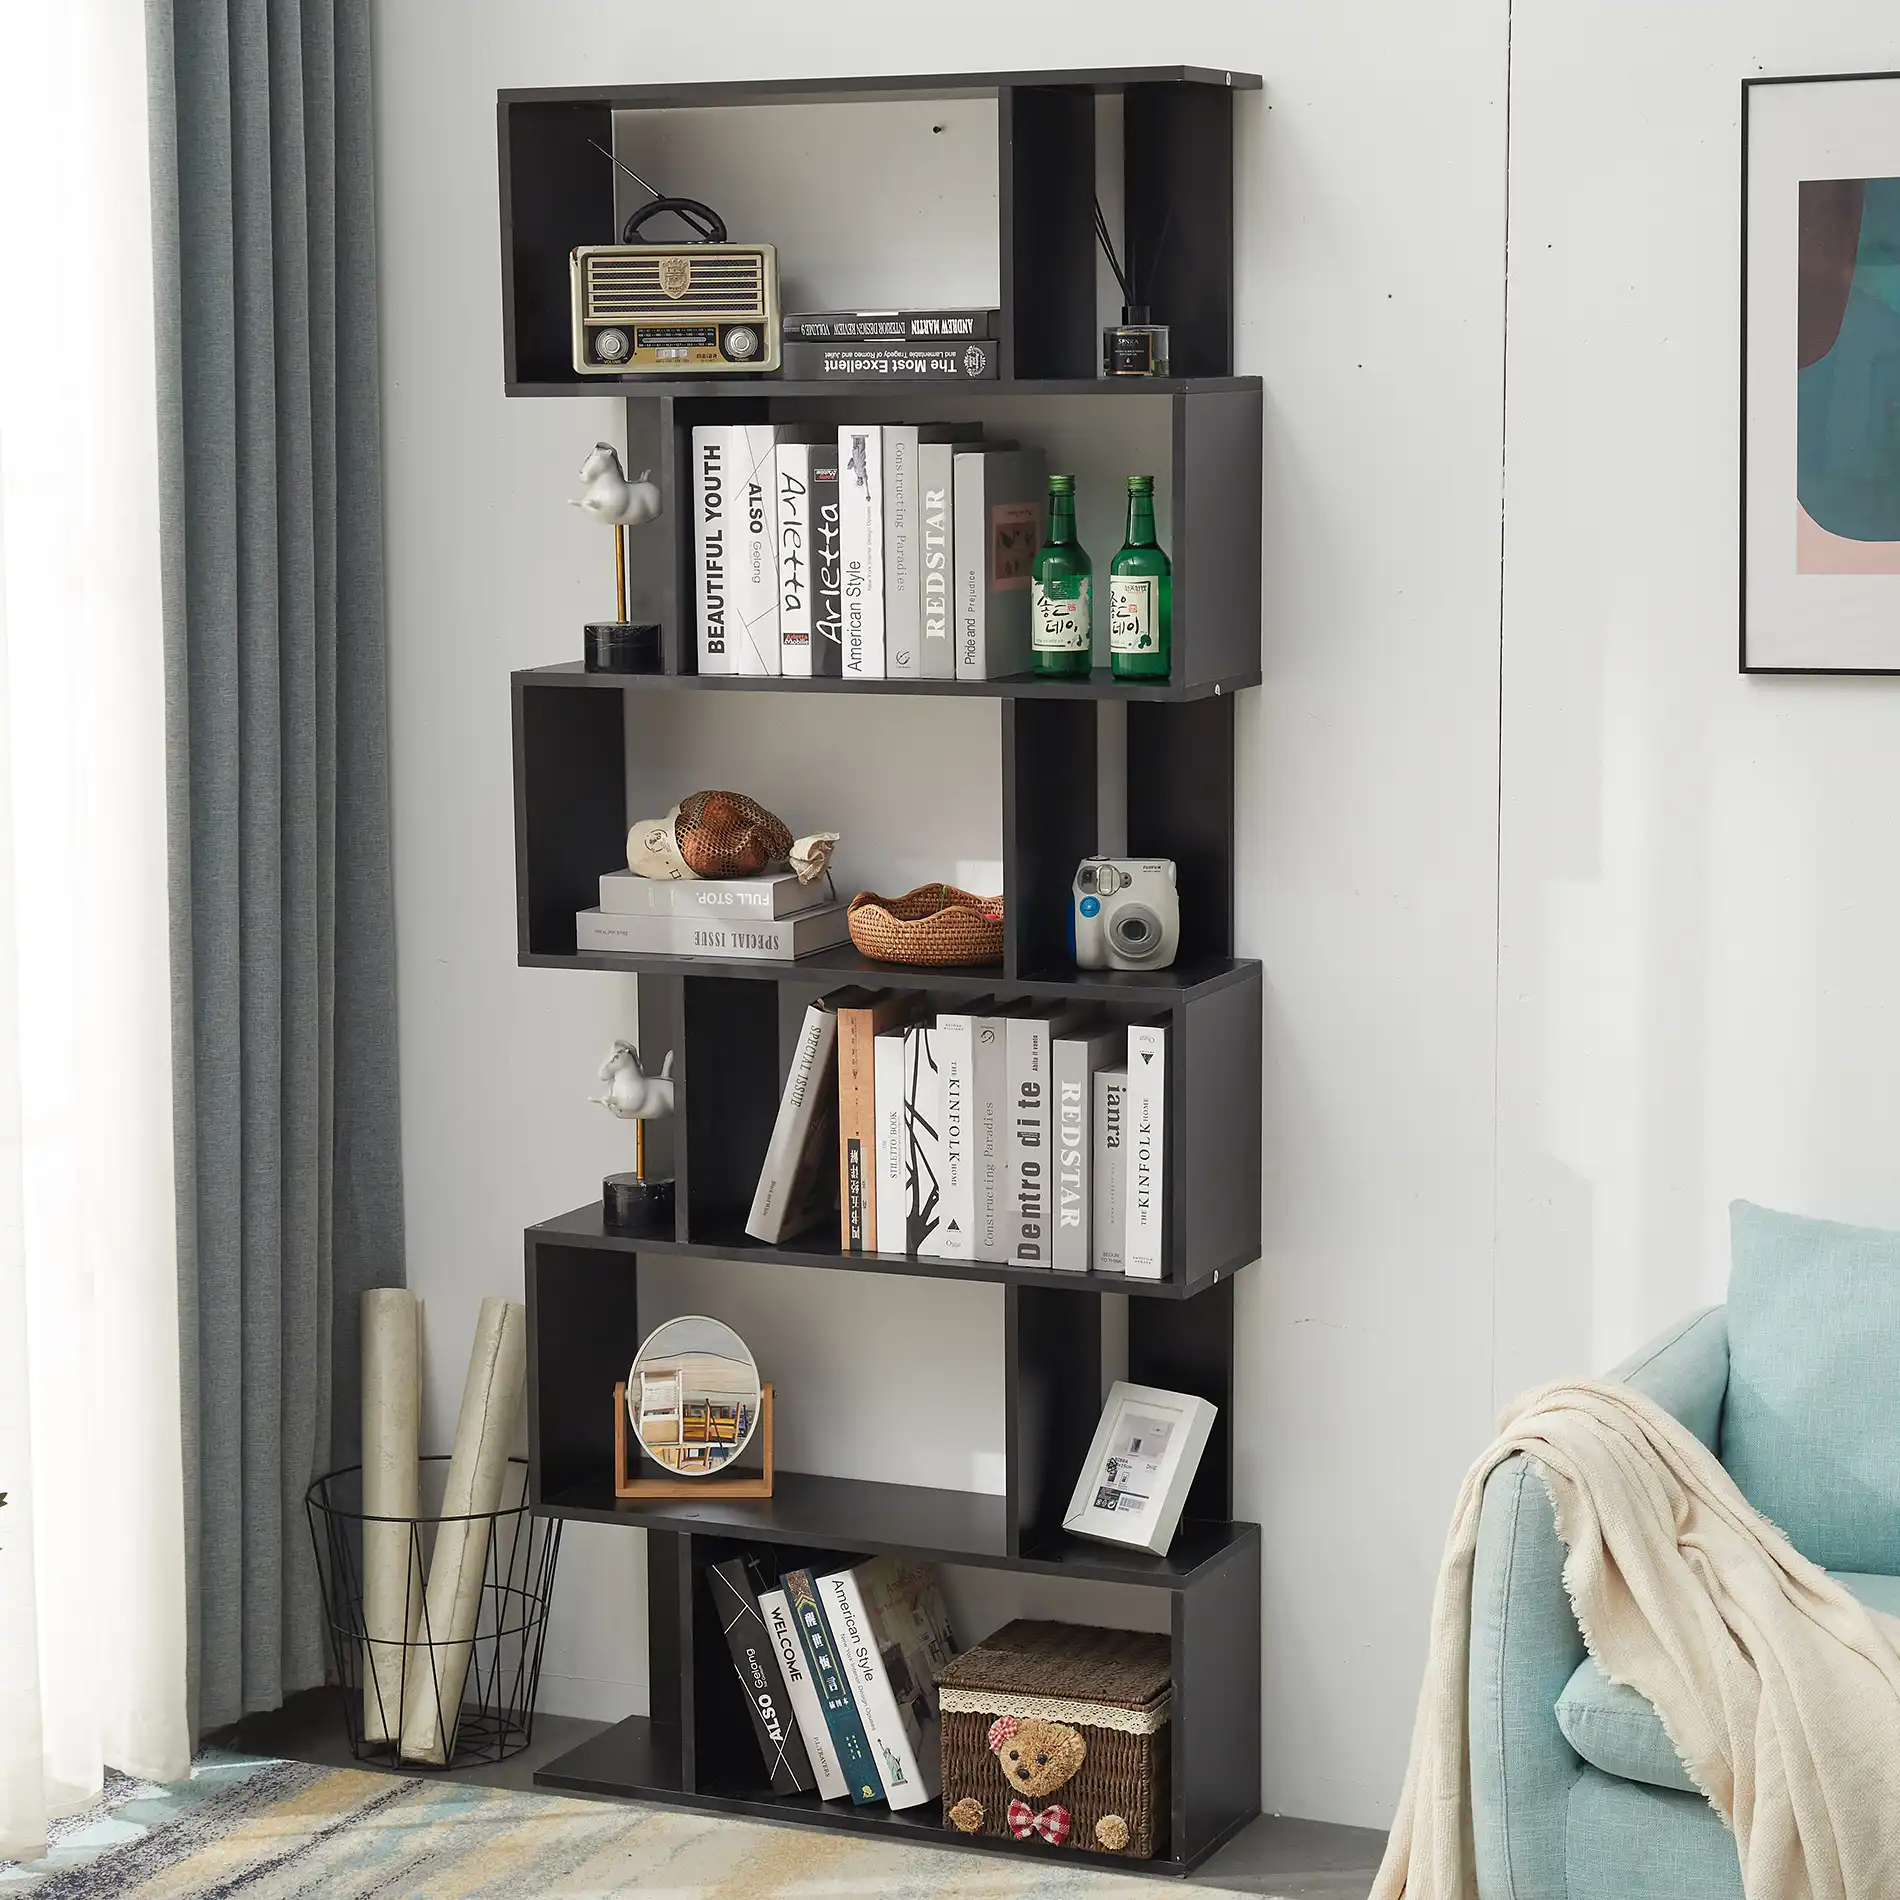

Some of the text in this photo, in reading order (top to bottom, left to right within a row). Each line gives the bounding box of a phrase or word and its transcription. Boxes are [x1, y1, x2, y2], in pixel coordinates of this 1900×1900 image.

[800, 324, 806, 336] 9
[806, 322, 830, 336] VOLUME
[833, 322, 856, 336] REVIEW
[856, 322, 878, 336] DESIGN
[878, 321, 906, 336] INTERIOR
[883, 350, 908, 358] Tragedy
[911, 319, 941, 335] MARTIN
[941, 318, 974, 335] ANDREW
[824, 358, 888, 373] Excellent
[892, 359, 926, 373] Most
[931, 358, 957, 372] The
[748, 482, 763, 584] ALSO Gelang
[780, 472, 806, 612] Arletta
[895, 442, 907, 592] Constructing Paradies
[703, 445, 725, 654] BEAUTIFUL YOUTH
[815, 503, 842, 645] Arletta
[925, 488, 946, 639] REDSTAR
[846, 561, 865, 672] American Style
[964, 570, 977, 665] Pride and Prejudice
[695, 891, 770, 907] FULL STOP.
[694, 931, 779, 950] SPECIAL ISSUE
[790, 1025, 822, 1108] SPECIAL ISSUE
[950, 1061, 958, 1076] THE
[889, 1111, 898, 1179] STILETTO BOOK
[948, 1078, 960, 1162] KINFOLK
[1106, 1085, 1127, 1149] ianra
[983, 1102, 996, 1247] Constructing Paradies
[1016, 1081, 1041, 1260] Dentro di te
[1061, 1080, 1081, 1228] REDSTAR
[1138, 1123, 1150, 1209] KINFOLK
[771, 1606, 803, 1683] WELCOME
[832, 1579, 874, 1682] American Style
[746, 1648, 763, 1689] Gelang
[857, 1684, 868, 1709] Design
[758, 1694, 784, 1742] ALSO
